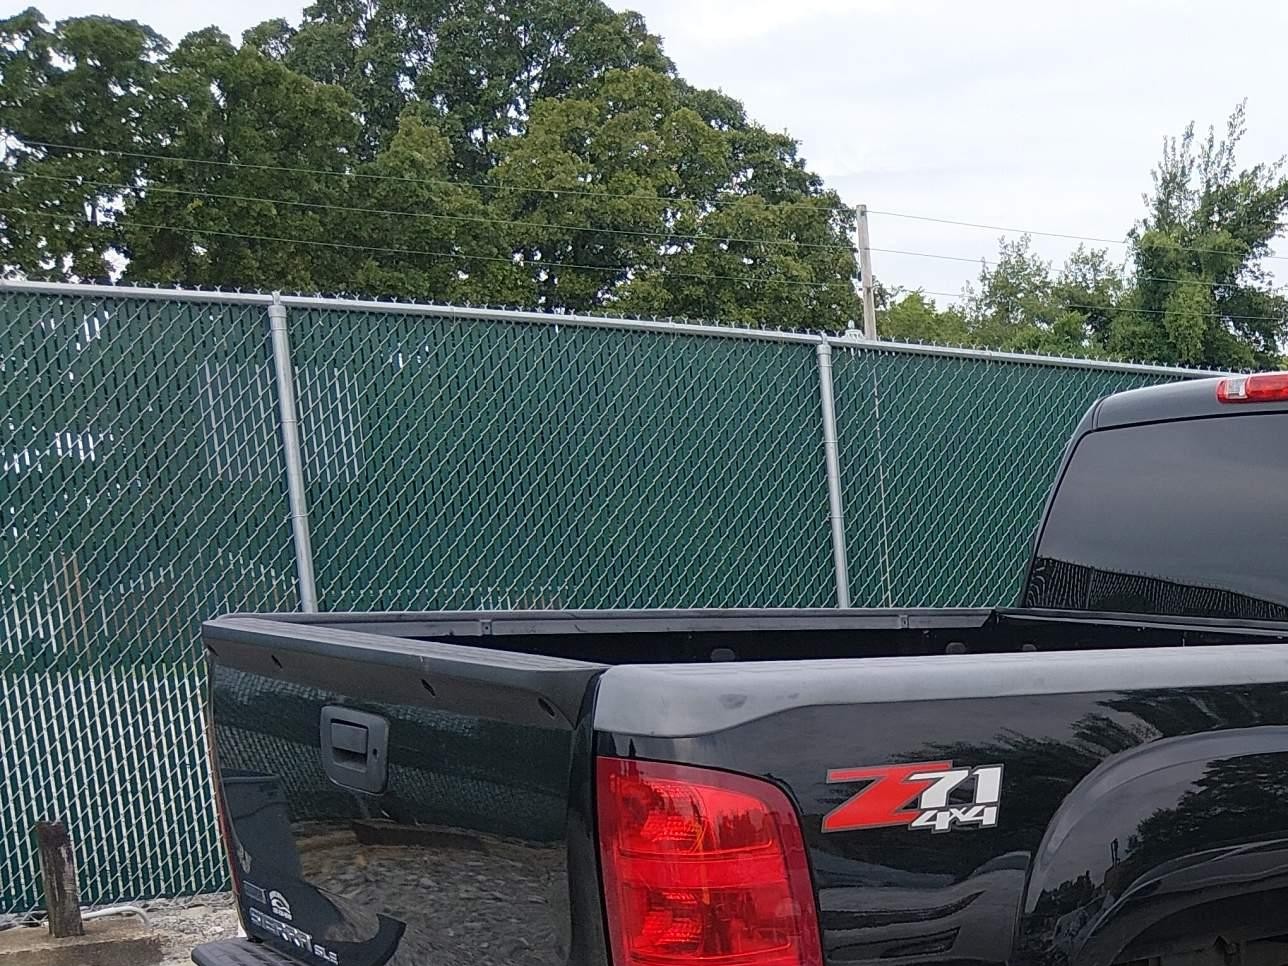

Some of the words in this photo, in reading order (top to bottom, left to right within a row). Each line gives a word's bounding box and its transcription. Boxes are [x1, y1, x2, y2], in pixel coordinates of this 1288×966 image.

[822, 760, 1004, 833] Z71
[249, 906, 313, 953] SIERRA
[313, 943, 339, 966] SLE
